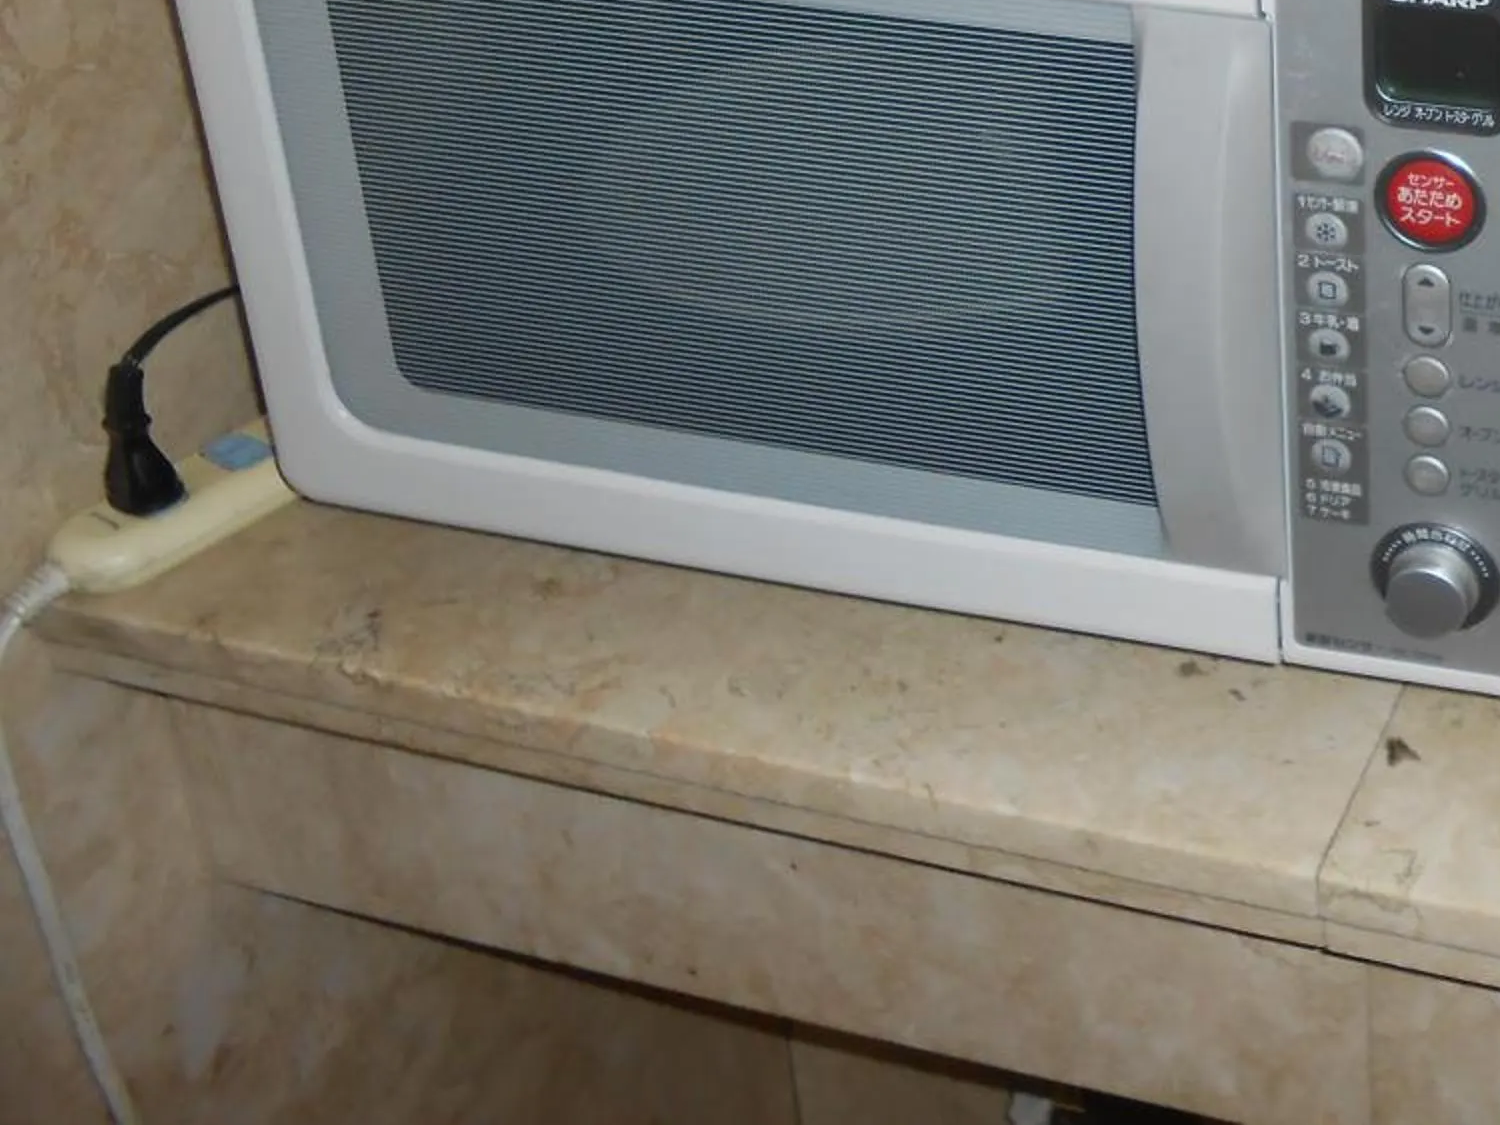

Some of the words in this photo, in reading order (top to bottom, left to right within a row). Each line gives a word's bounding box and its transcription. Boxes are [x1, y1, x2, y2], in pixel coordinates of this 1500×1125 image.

[1408, 174, 1455, 188] センサー
[1397, 186, 1463, 210] あたため
[1401, 208, 1461, 227] スタート
